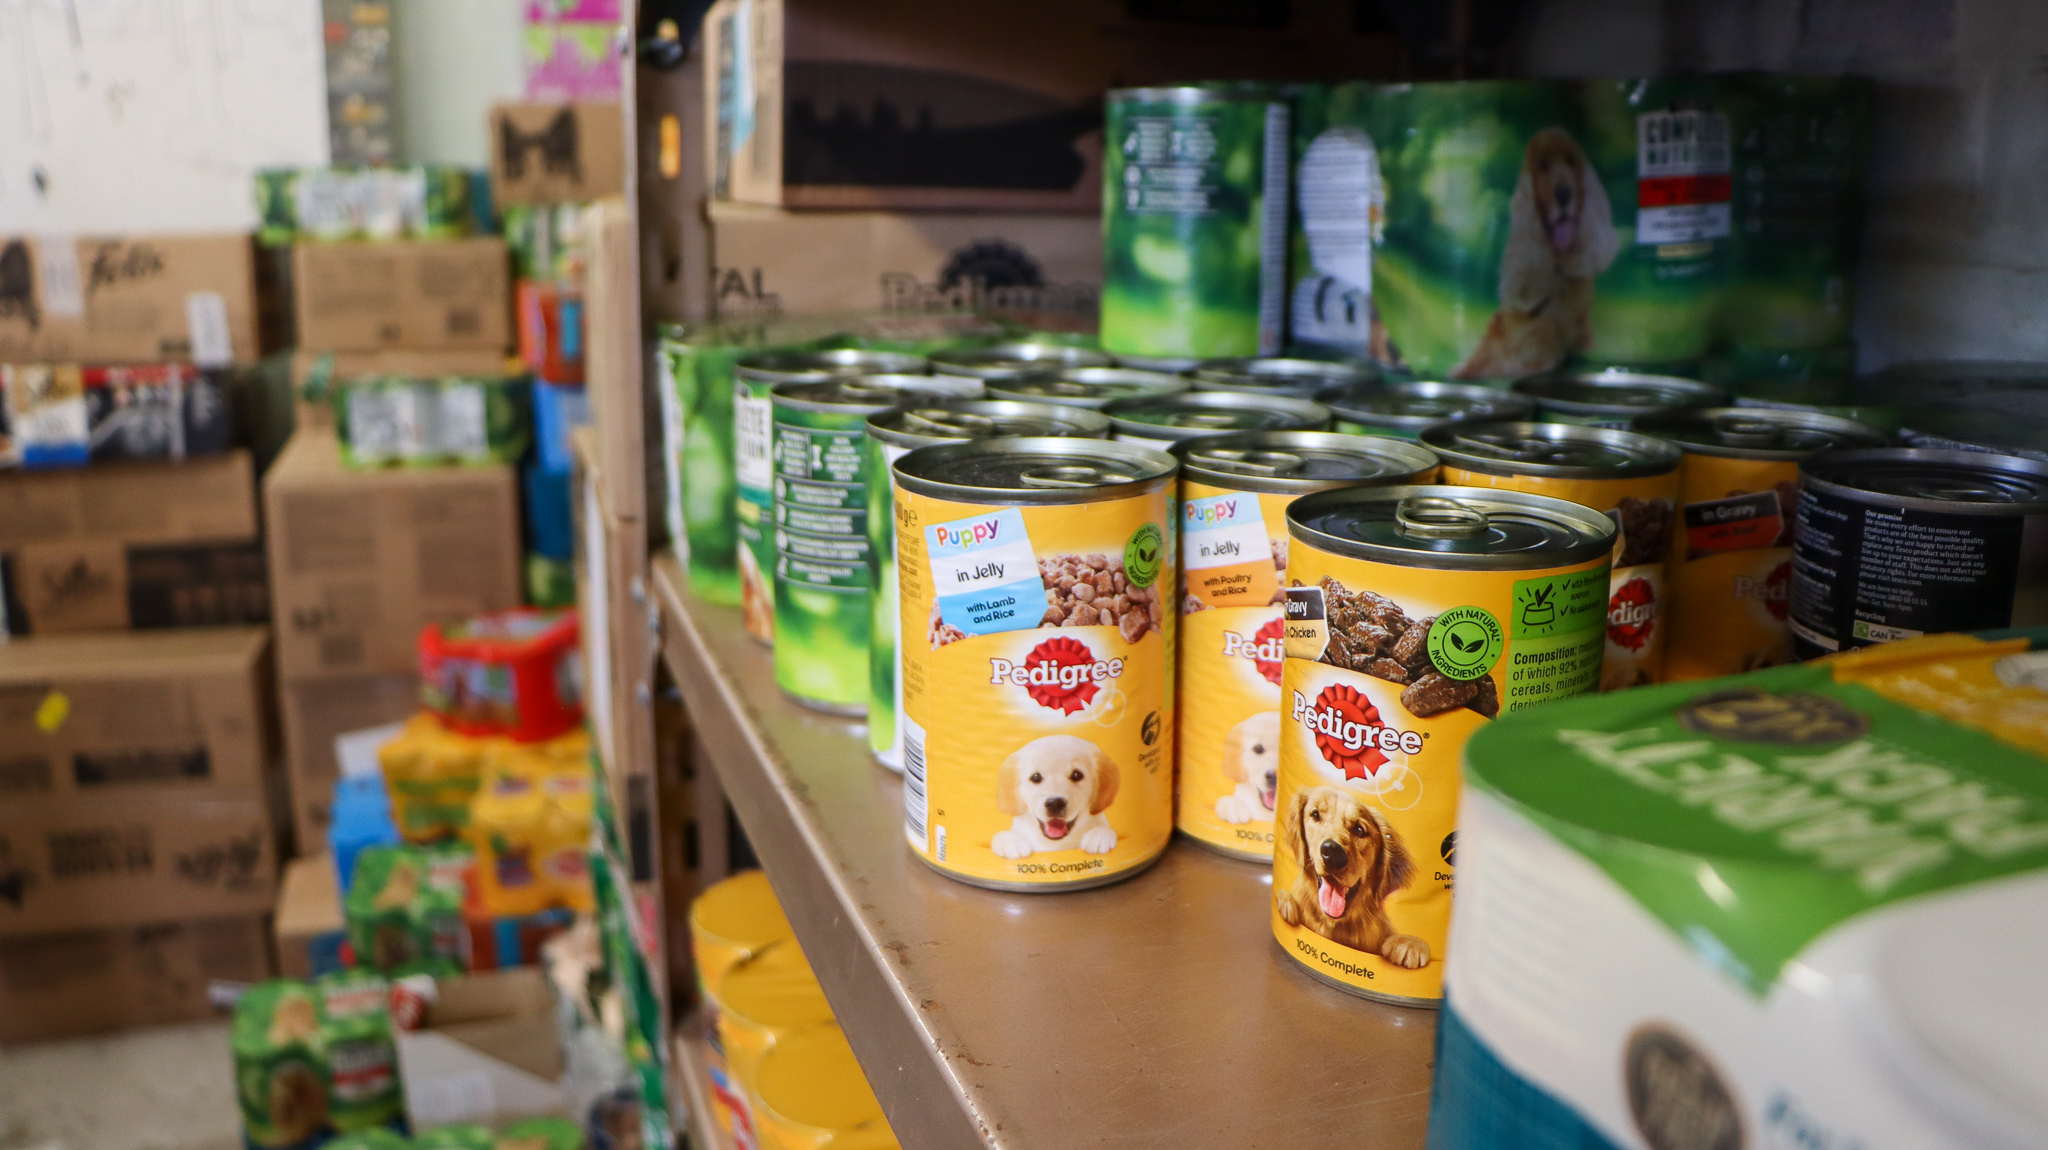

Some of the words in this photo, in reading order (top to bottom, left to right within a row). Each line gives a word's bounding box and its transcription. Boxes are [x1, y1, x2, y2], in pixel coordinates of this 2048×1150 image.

[1186, 499, 1238, 527] Puppy
[1700, 508, 1715, 521] in
[1716, 504, 1757, 519] Gravy
[1865, 510, 1877, 518] Our
[1877, 511, 1902, 521] promise
[935, 518, 1000, 549] Puppy
[1874, 518, 1890, 527] make
[1891, 521, 1907, 530] every
[1908, 524, 1927, 532] effort
[1864, 525, 1889, 535] products
[1934, 535, 1960, 543] possible
[1881, 536, 1893, 544] why
[1916, 541, 1935, 549] happy
[1199, 544, 1211, 557] in
[1213, 540, 1240, 556] Jelly
[1913, 549, 1938, 557] product
[1904, 554, 1944, 565] expectations.
[955, 568, 970, 583] in
[972, 563, 1004, 580] Jelly
[1221, 574, 1252, 586] Poultry
[1937, 574, 1976, 582] information
[1228, 585, 1247, 595] Rice
[966, 603, 987, 613] with
[986, 595, 1016, 610] Lamb
[1288, 598, 1307, 617] Gravy
[973, 613, 993, 624] and
[993, 608, 1015, 620] Rice
[1855, 609, 1886, 623] Recycling
[1290, 626, 1317, 639] Chicken
[1439, 610, 1464, 627] WITH
[1465, 609, 1500, 641] NATURAL
[1870, 630, 1888, 640] CAN
[1431, 649, 1487, 678] INGREDIENTS
[1514, 647, 1576, 665] Composition:
[990, 657, 1124, 690] Pedigree
[1513, 670, 1525, 680] of
[1528, 667, 1556, 680] which
[1559, 661, 1578, 674] 92%
[1512, 681, 1553, 696] cereals,
[1292, 689, 1423, 752] Pedigree
[1017, 863, 1047, 873] 100%
[1049, 858, 1104, 873] Complete
[1296, 939, 1318, 959] 100%
[1320, 952, 1375, 980] Complete
